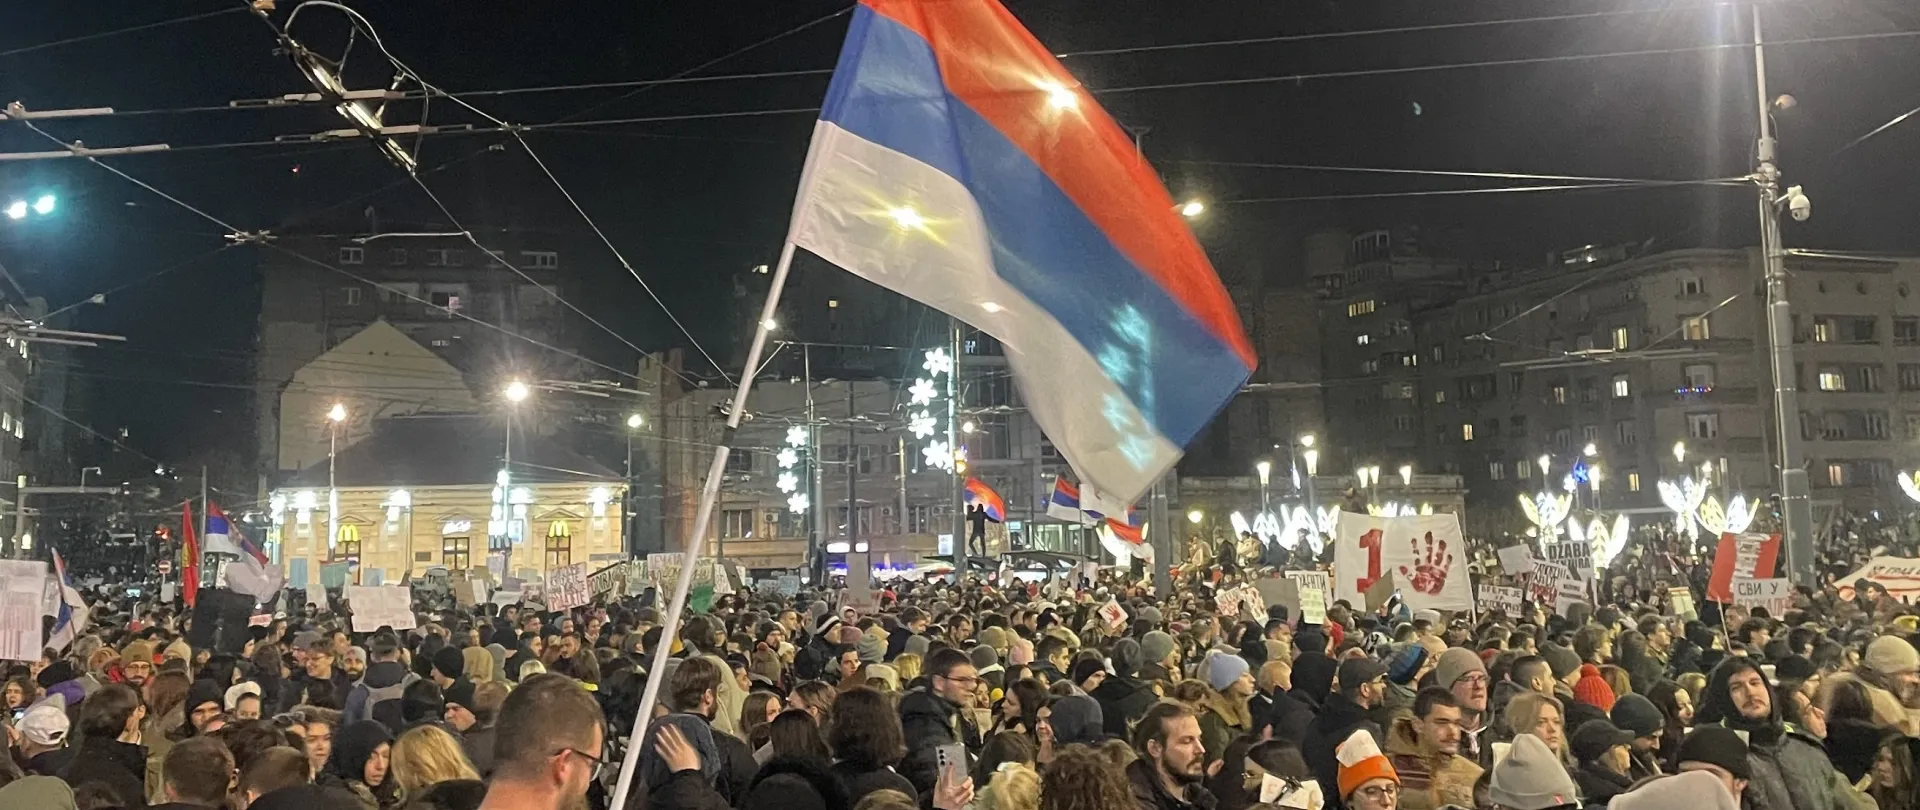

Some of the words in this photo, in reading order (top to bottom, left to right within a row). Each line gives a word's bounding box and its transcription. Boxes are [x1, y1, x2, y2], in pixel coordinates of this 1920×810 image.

[1549, 541, 1591, 560] DŽABA
[1738, 582, 1762, 596] СВИ
[1770, 582, 1778, 595] У
